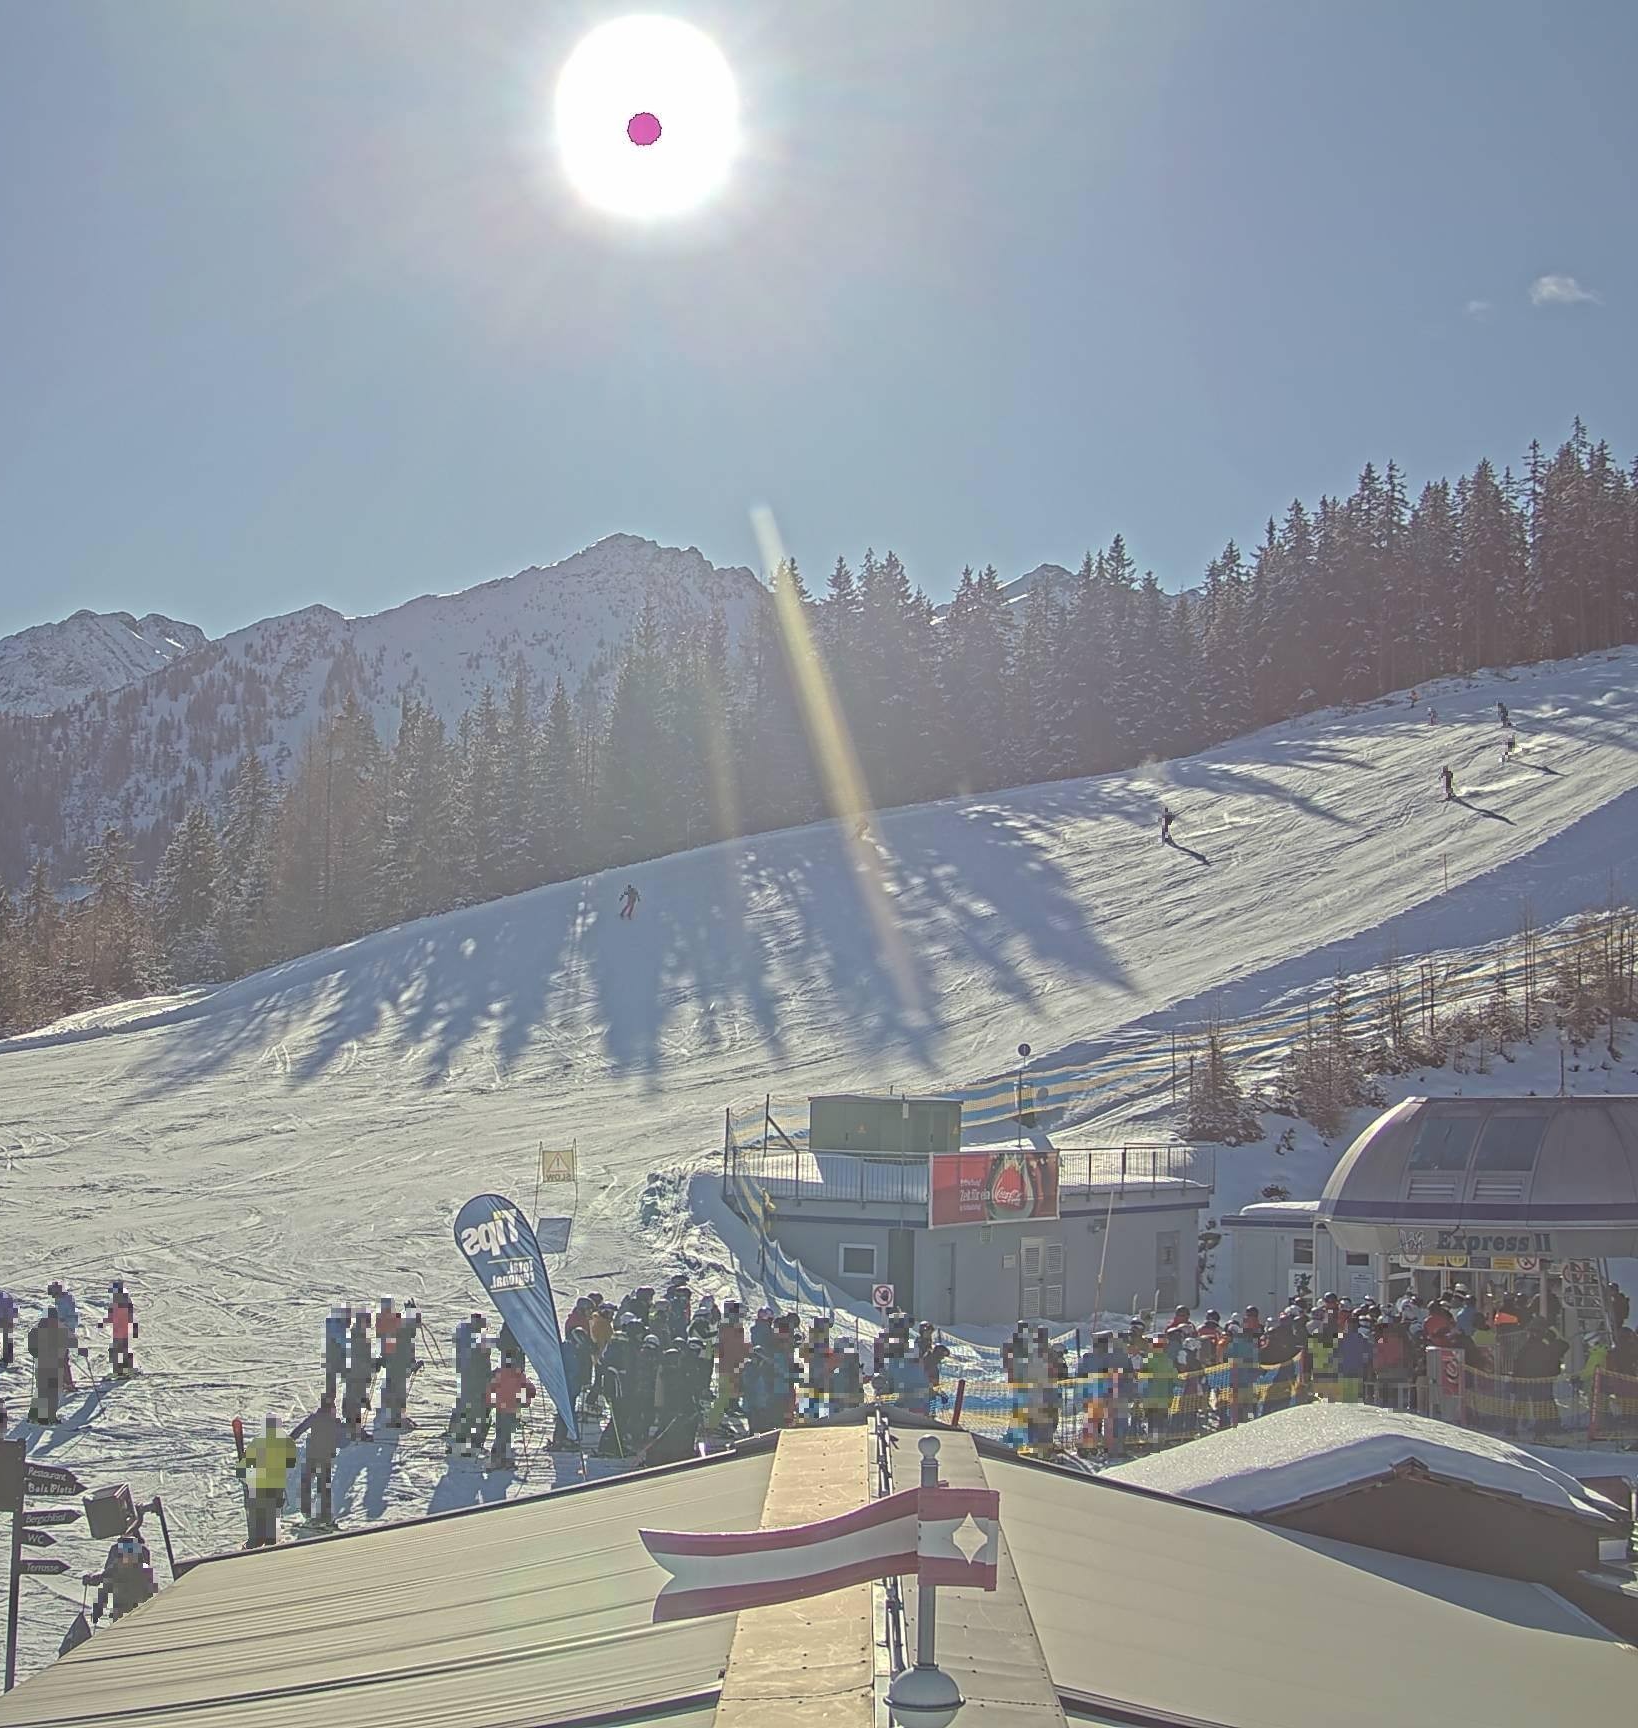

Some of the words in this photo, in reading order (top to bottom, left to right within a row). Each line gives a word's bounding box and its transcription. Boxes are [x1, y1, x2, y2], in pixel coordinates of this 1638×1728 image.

[1437, 1230, 1530, 1255] Express
[1534, 1232, 1552, 1252] II
[28, 1467, 66, 1482] Restaurant
[28, 1534, 44, 1544] WC
[27, 1562, 60, 1572] Terrasse
